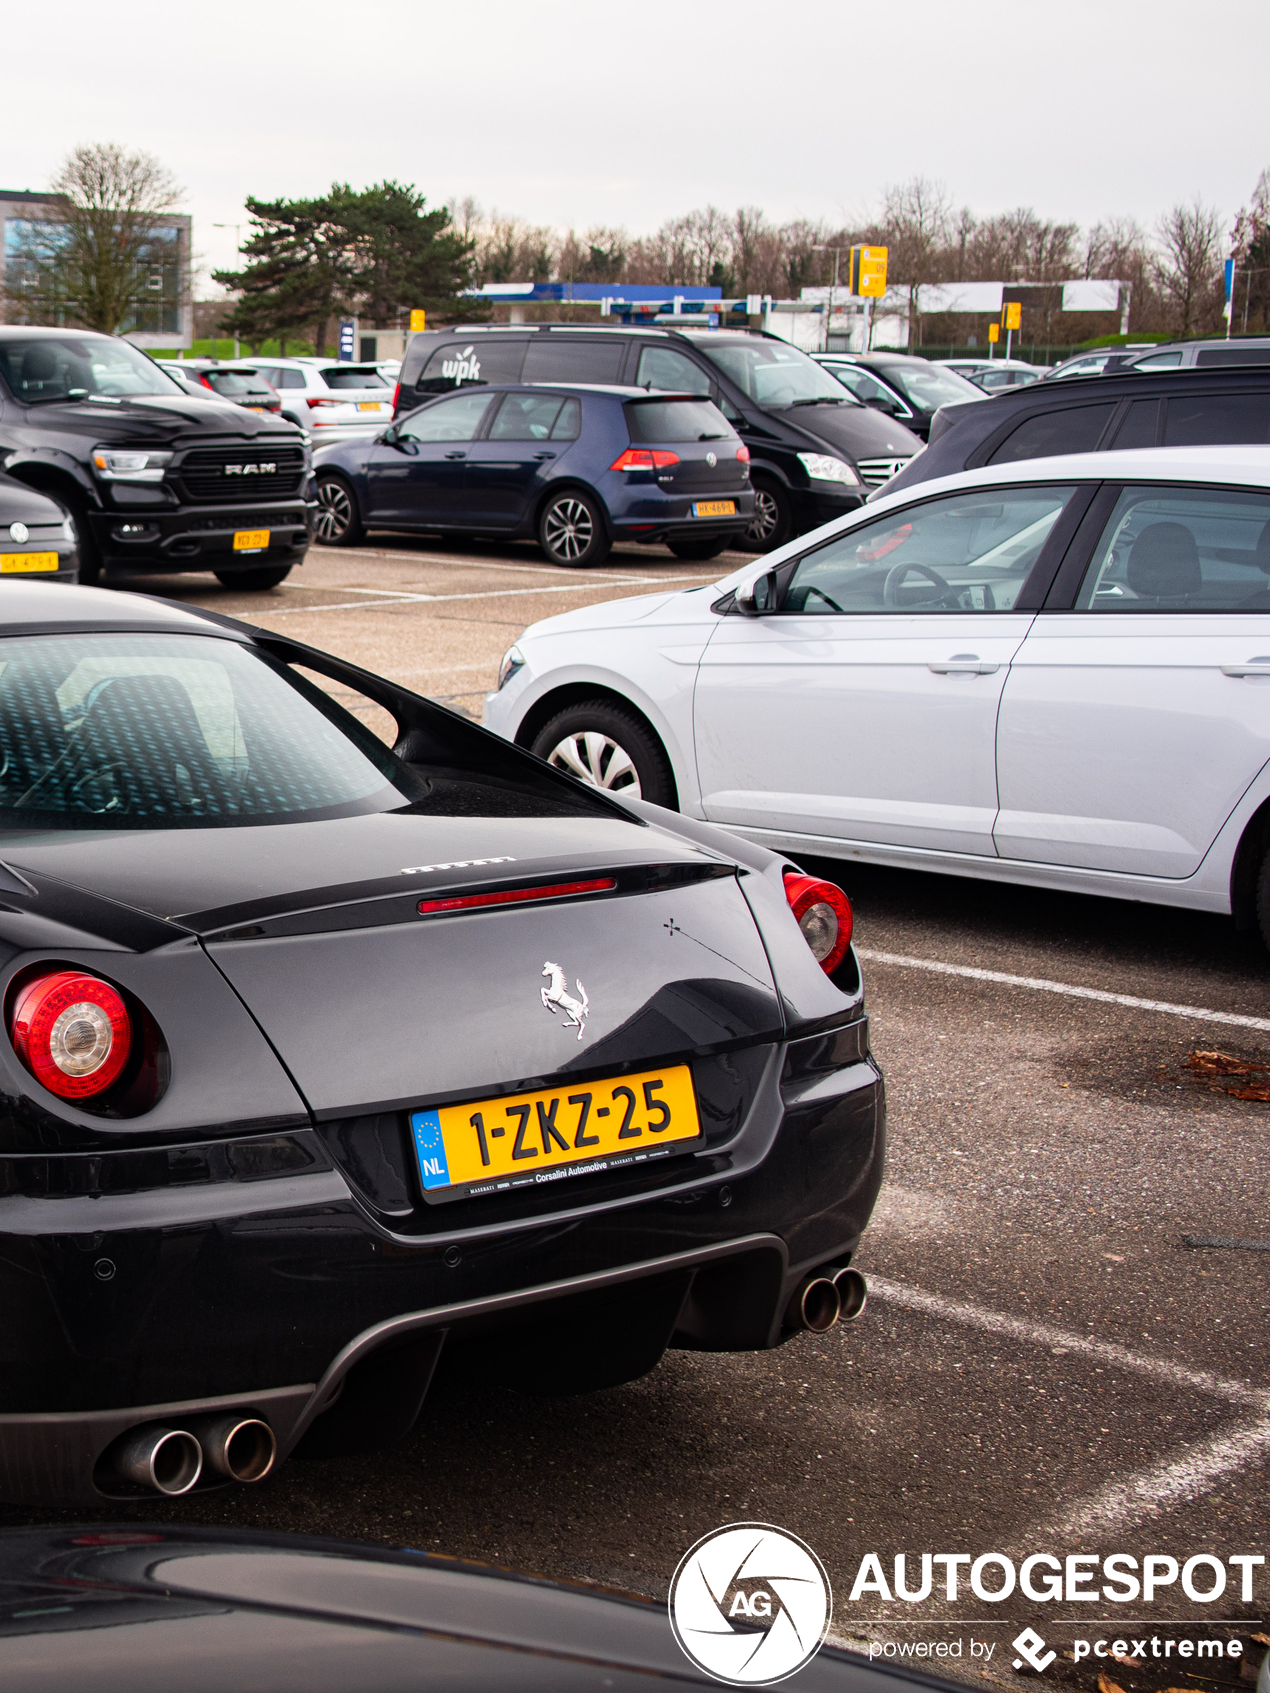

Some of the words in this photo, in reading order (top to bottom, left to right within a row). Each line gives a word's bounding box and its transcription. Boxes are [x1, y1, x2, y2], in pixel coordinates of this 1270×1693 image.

[442, 354, 481, 387] wpk
[225, 463, 276, 475] RAM
[469, 1079, 672, 1167] 1-ZKZ-25
[422, 1157, 446, 1178] NL
[535, 1169, 568, 1184] Corsalini
[568, 1160, 608, 1177] Automotive
